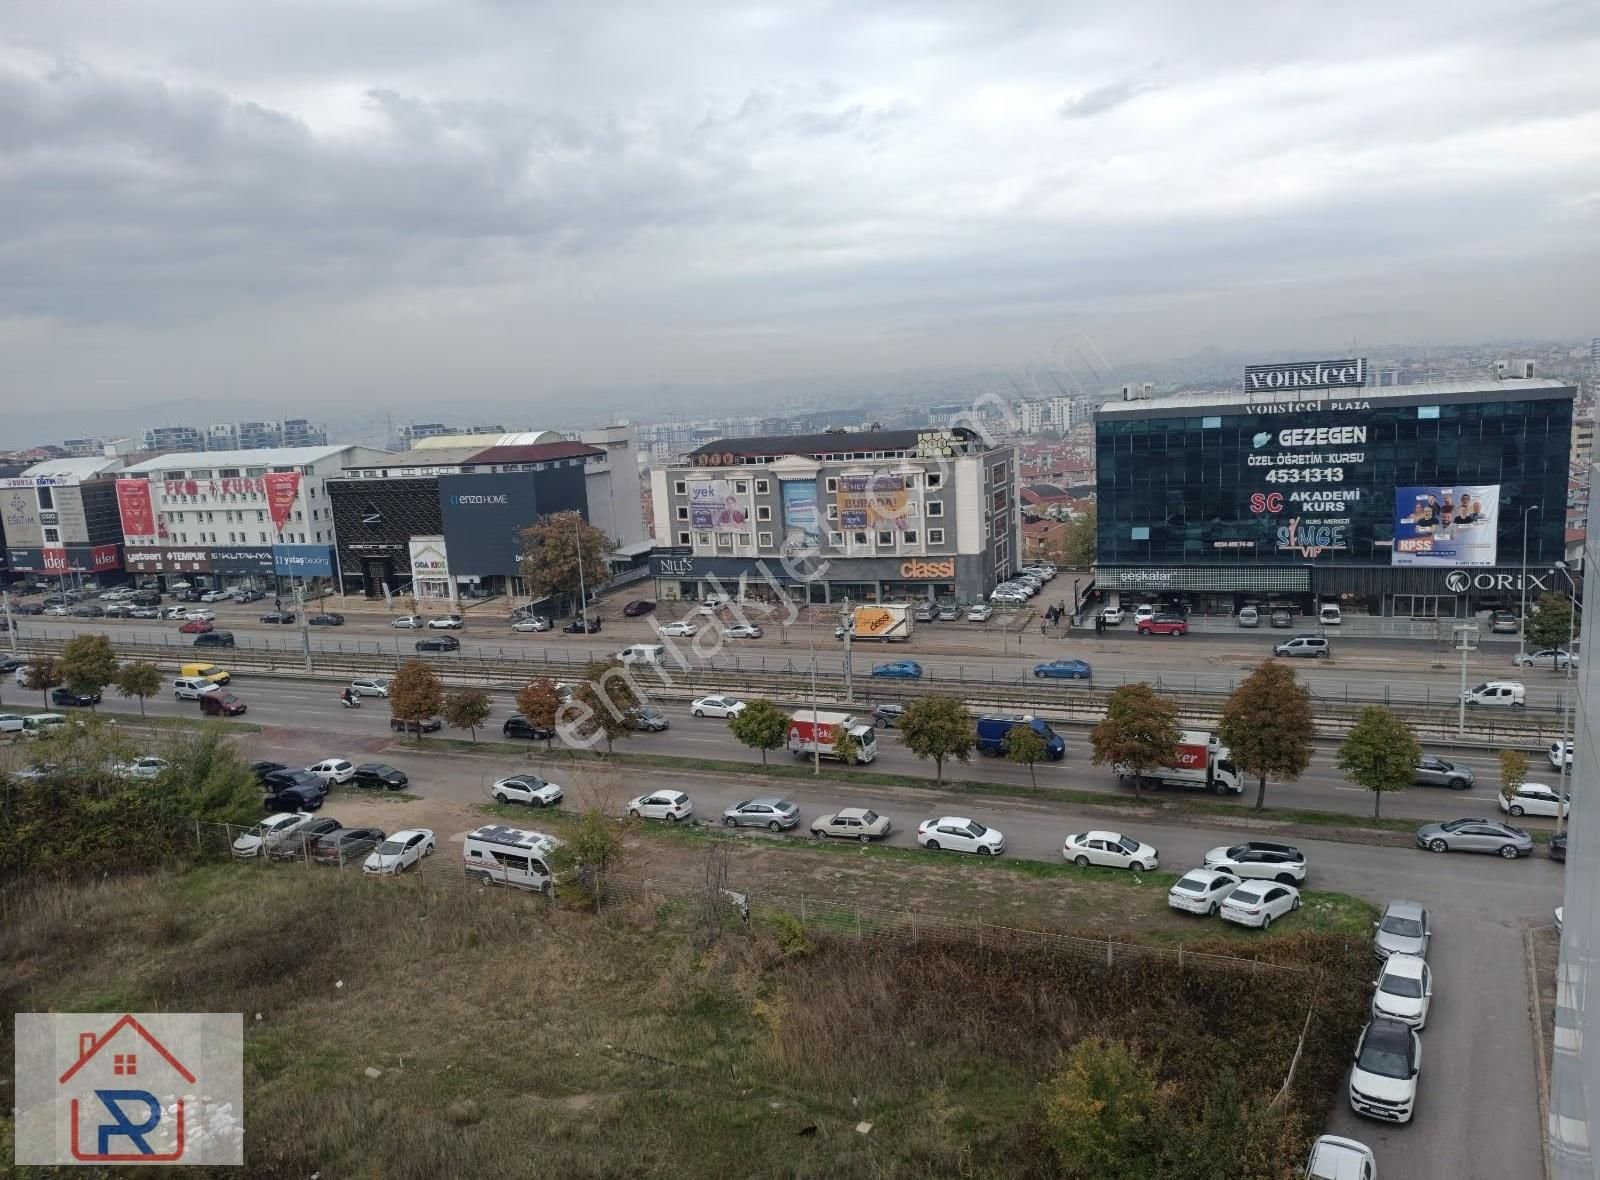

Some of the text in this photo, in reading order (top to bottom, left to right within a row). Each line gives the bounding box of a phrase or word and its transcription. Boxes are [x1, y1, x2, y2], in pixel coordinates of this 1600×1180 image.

[1249, 358, 1362, 388] vonsteel
[1245, 400, 1370, 415] vonsteel PLAZA
[1278, 425, 1367, 447] GEZEGEN
[1247, 452, 1365, 466] ÖZEL ÖĞRETİM KURSU
[693, 484, 715, 500] yek
[1289, 488, 1361, 502] AKADEMİ
[1250, 492, 1283, 513] SC
[1302, 502, 1345, 512] KURS
[1301, 546, 1322, 558] VIP
[1400, 540, 1432, 551] KPSS
[414, 561, 430, 569] ODA
